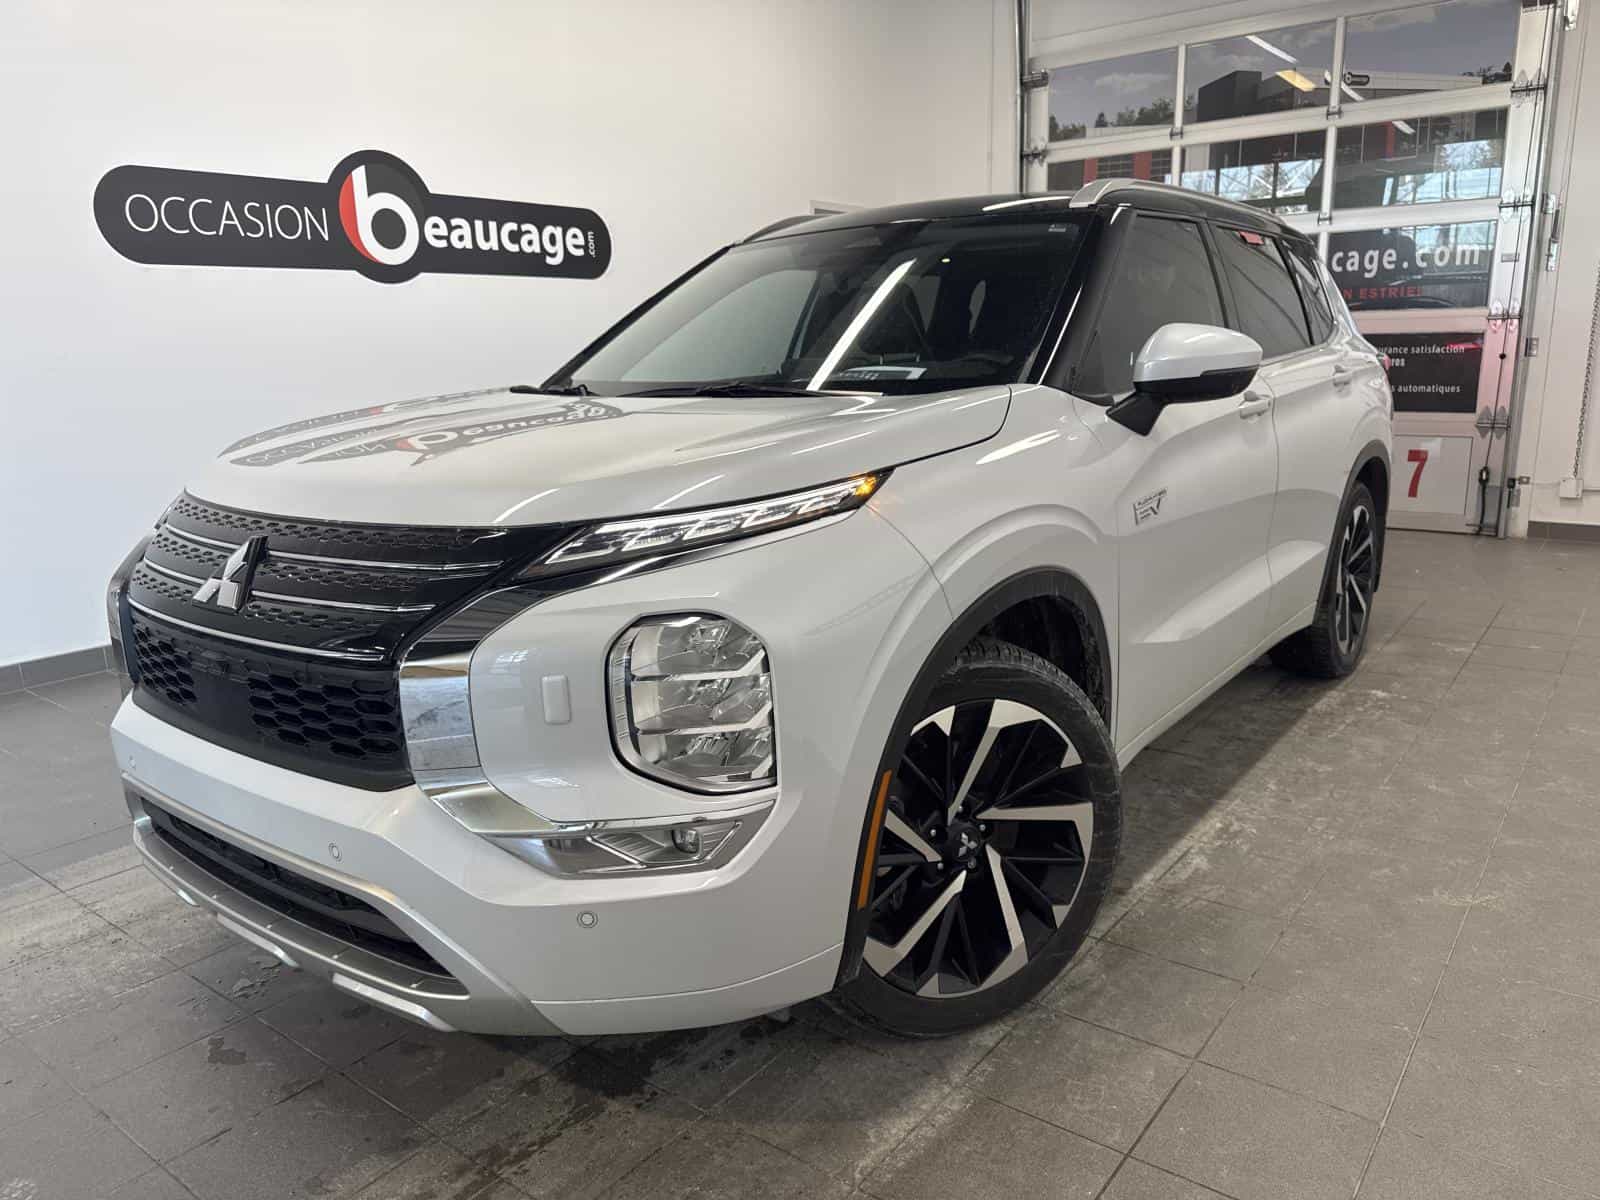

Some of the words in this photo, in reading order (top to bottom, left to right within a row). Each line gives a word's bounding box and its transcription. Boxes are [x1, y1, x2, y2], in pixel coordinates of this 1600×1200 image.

[125, 193, 329, 241] OCCASION
[1410, 344, 1465, 354] satisfaction
[1397, 384, 1461, 395] automatiques
[1407, 449, 1429, 498] 7
